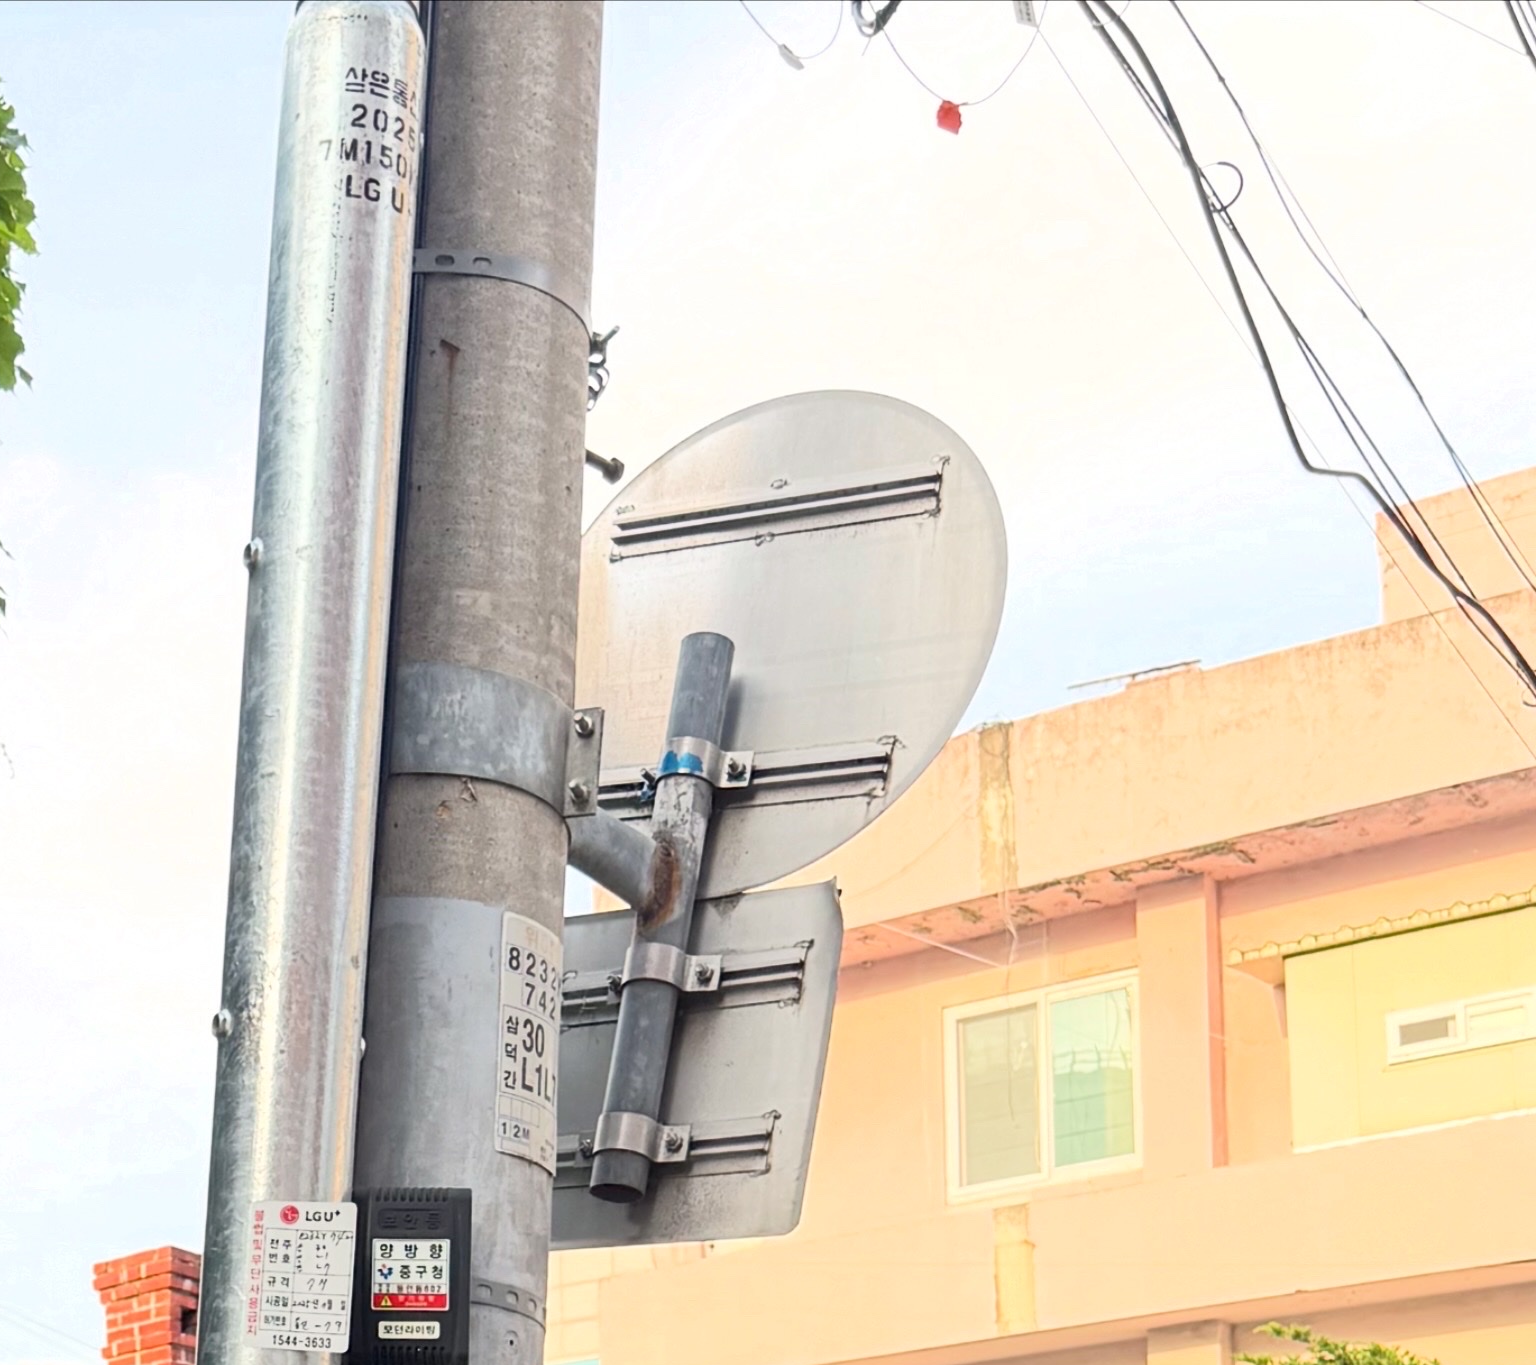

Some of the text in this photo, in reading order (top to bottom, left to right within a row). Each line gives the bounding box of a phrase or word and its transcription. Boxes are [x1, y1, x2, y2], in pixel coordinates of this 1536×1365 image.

[345, 174, 381, 202] LG
[525, 982, 556, 1021] 742
[522, 1018, 545, 1058] 30
[399, 1264, 443, 1280] 중구청
[273, 1335, 332, 1349] 1544-3633
